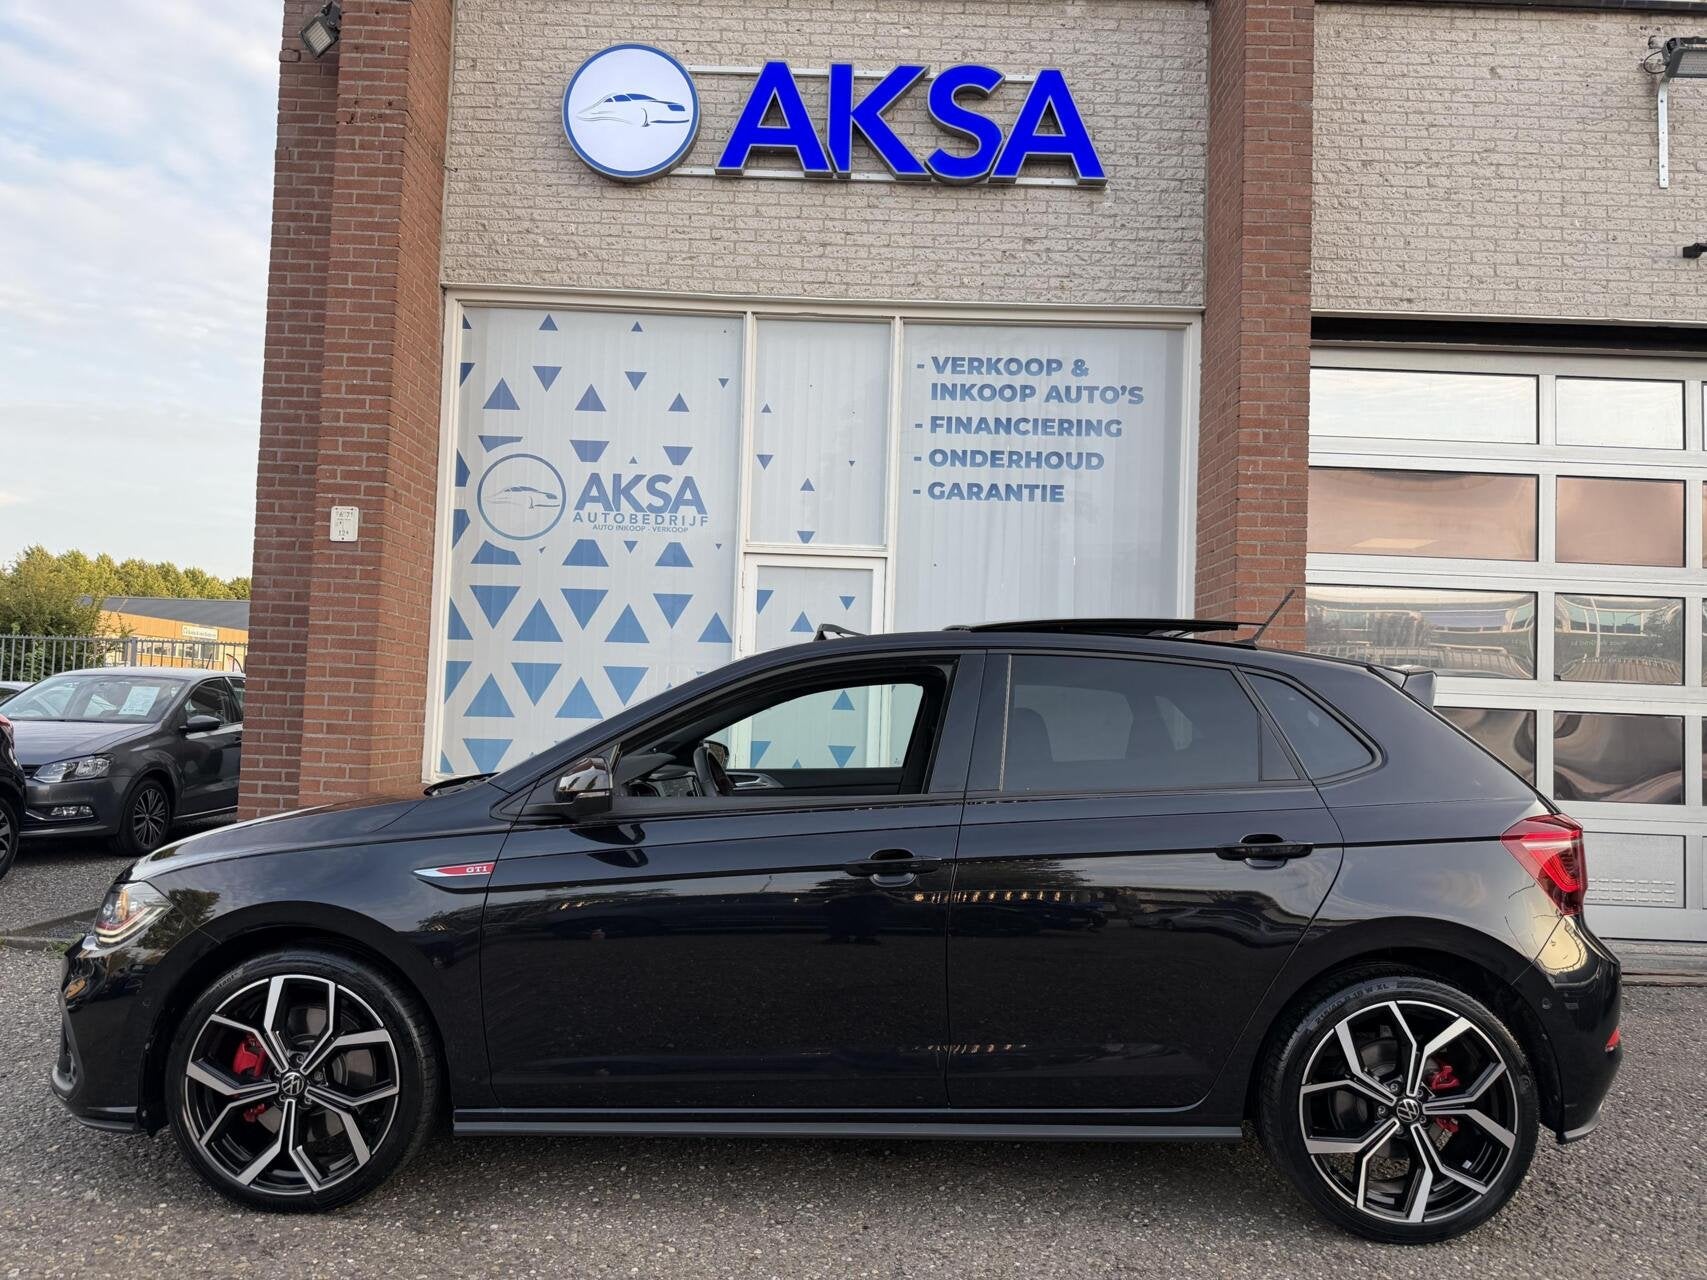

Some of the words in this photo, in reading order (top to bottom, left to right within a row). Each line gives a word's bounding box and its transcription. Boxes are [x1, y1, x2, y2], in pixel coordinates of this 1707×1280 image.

[715, 59, 1108, 187] AKSA
[931, 356, 1063, 377] VERKOOP
[1071, 358, 1090, 377] &
[931, 382, 1036, 402] INKOOP
[930, 415, 1122, 438] FINANCIERING
[928, 448, 1105, 470] ONDERHOUD
[574, 472, 708, 515] AKSA
[927, 481, 1065, 503] GARANTIE
[572, 511, 709, 527] AUTOBEDRIJF
[615, 524, 646, 532] INKOOP
[652, 525, 689, 533] VERKOOP
[466, 865, 488, 873] GTI
